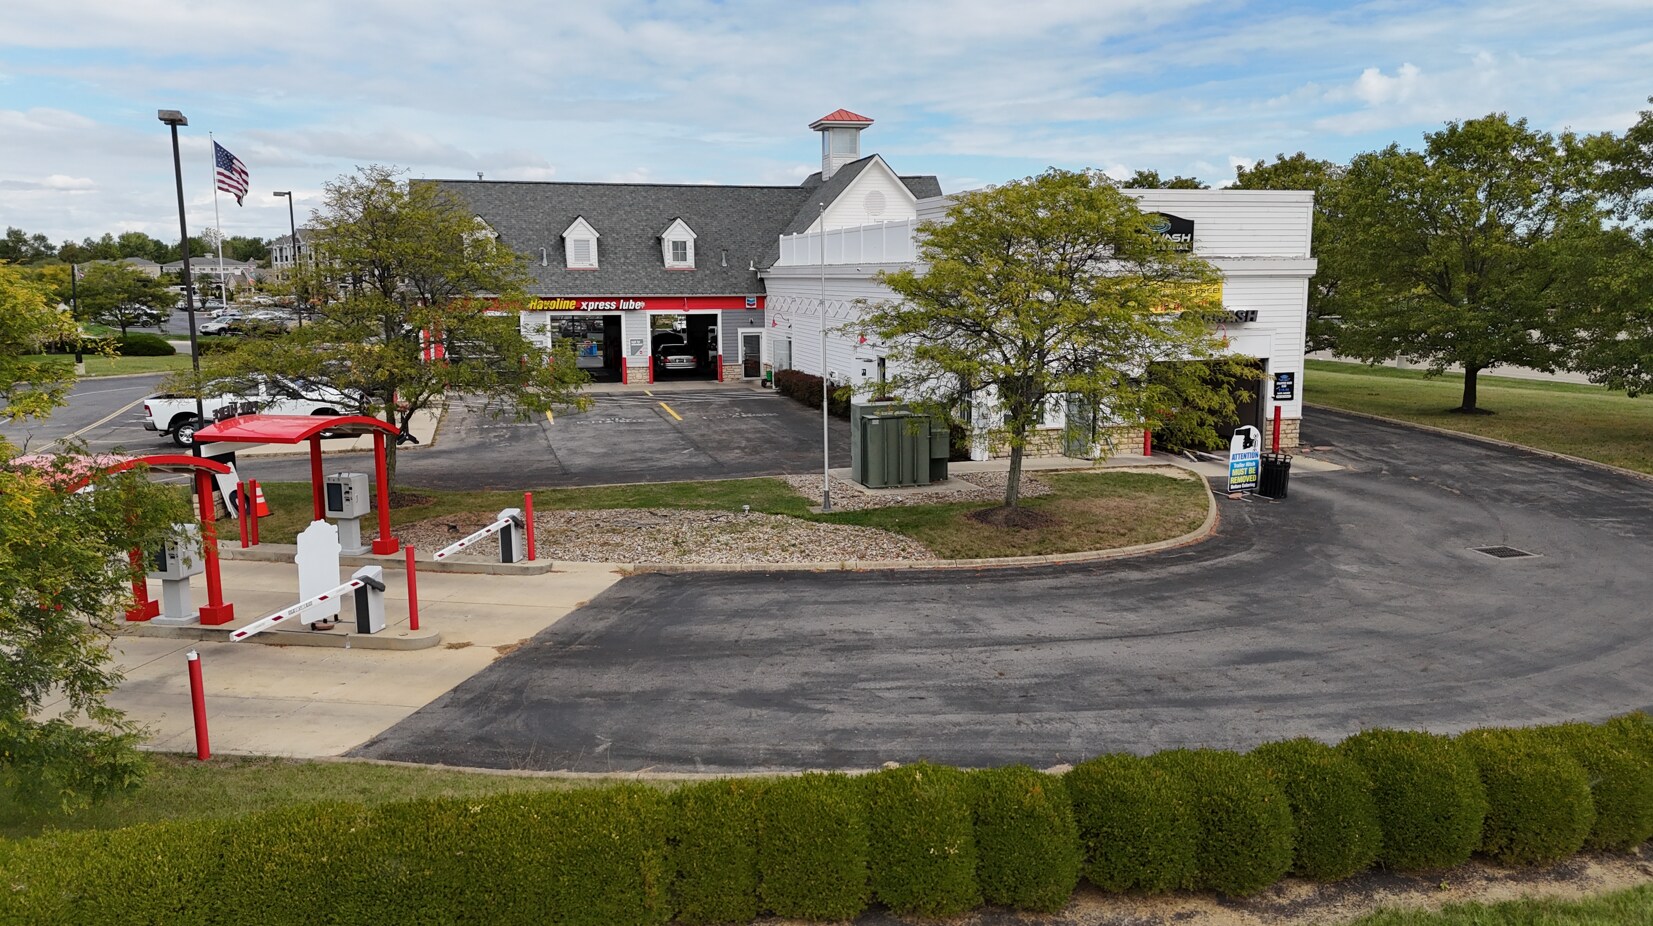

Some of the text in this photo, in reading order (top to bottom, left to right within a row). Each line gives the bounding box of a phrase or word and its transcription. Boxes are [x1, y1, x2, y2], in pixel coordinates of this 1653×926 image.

[529, 298, 577, 310] Havoline
[580, 300, 617, 312] xpress
[1231, 452, 1259, 461] ATTENTION
[1232, 467, 1256, 476] MUST BE
[1230, 475, 1257, 484] REMOVED
